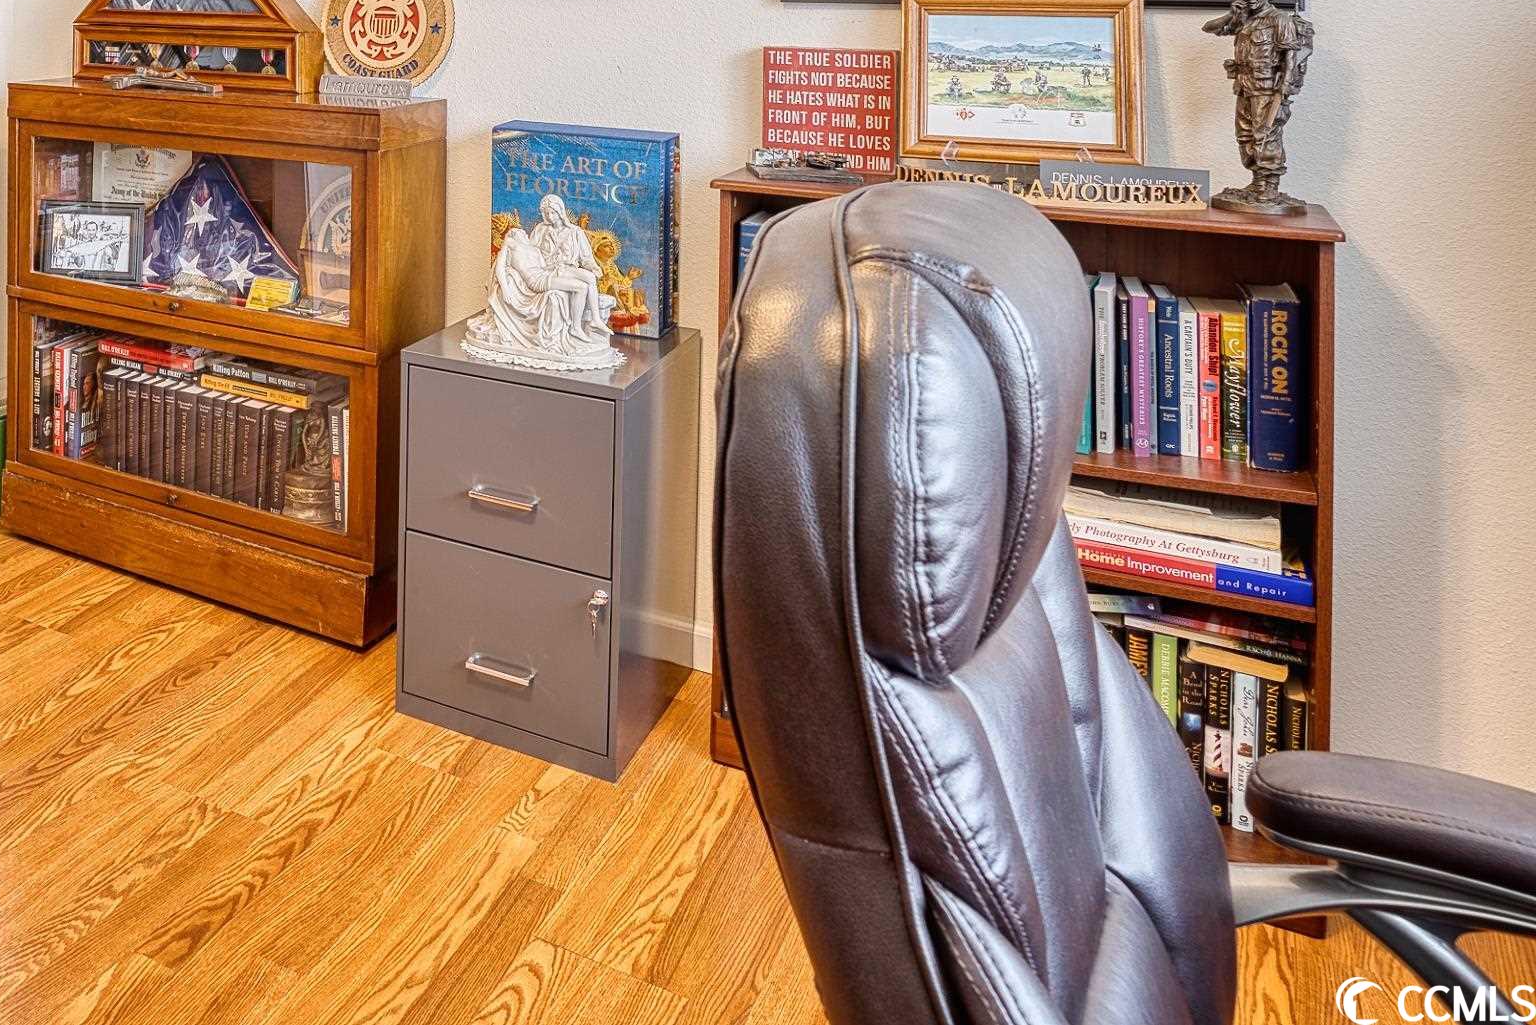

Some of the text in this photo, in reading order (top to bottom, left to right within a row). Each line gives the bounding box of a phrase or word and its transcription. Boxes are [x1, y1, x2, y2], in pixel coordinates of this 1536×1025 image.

[342, 53, 419, 79] COAST GUARD
[768, 51, 891, 69] THE TRUE SOLDIER
[769, 70, 891, 89] FIGHTS NOT BECAUSE
[768, 90, 890, 110] HE HATES WHAT IS IN
[768, 110, 890, 130] FRONT OF HIM, BUT
[768, 129, 890, 150] BECAUSE HE LOVES
[508, 148, 647, 179] THE ART OF
[867, 156, 890, 171] HIM
[895, 165, 1208, 204] DENNIS LAMOUREUX
[1051, 172, 1102, 185] DENNIS
[1184, 325, 1192, 358] CAPTAIN'S
[1208, 318, 1218, 376] Abandon Ship!
[1271, 310, 1288, 362] ROCK
[213, 364, 250, 379] Killing Patton
[1164, 334, 1174, 398] Ancestral Roots
[1184, 359, 1192, 374] DUTY
[1224, 338, 1247, 427] Mayflower
[1272, 366, 1288, 393] ON
[1085, 525, 1240, 564] Photography At Gettysburg
[1078, 547, 1287, 597] Home Improvement and Repair
[1161, 643, 1170, 675] DEBBIE
[1276, 651, 1304, 664] HANNA
[1183, 678, 1202, 688] Bend
[1191, 671, 1197, 679] A
[1182, 696, 1203, 706] Road
[1209, 673, 1219, 716] SPARKS
[1220, 670, 1230, 726] NICHOLAS
[1266, 684, 1279, 742] NICHOLAS
